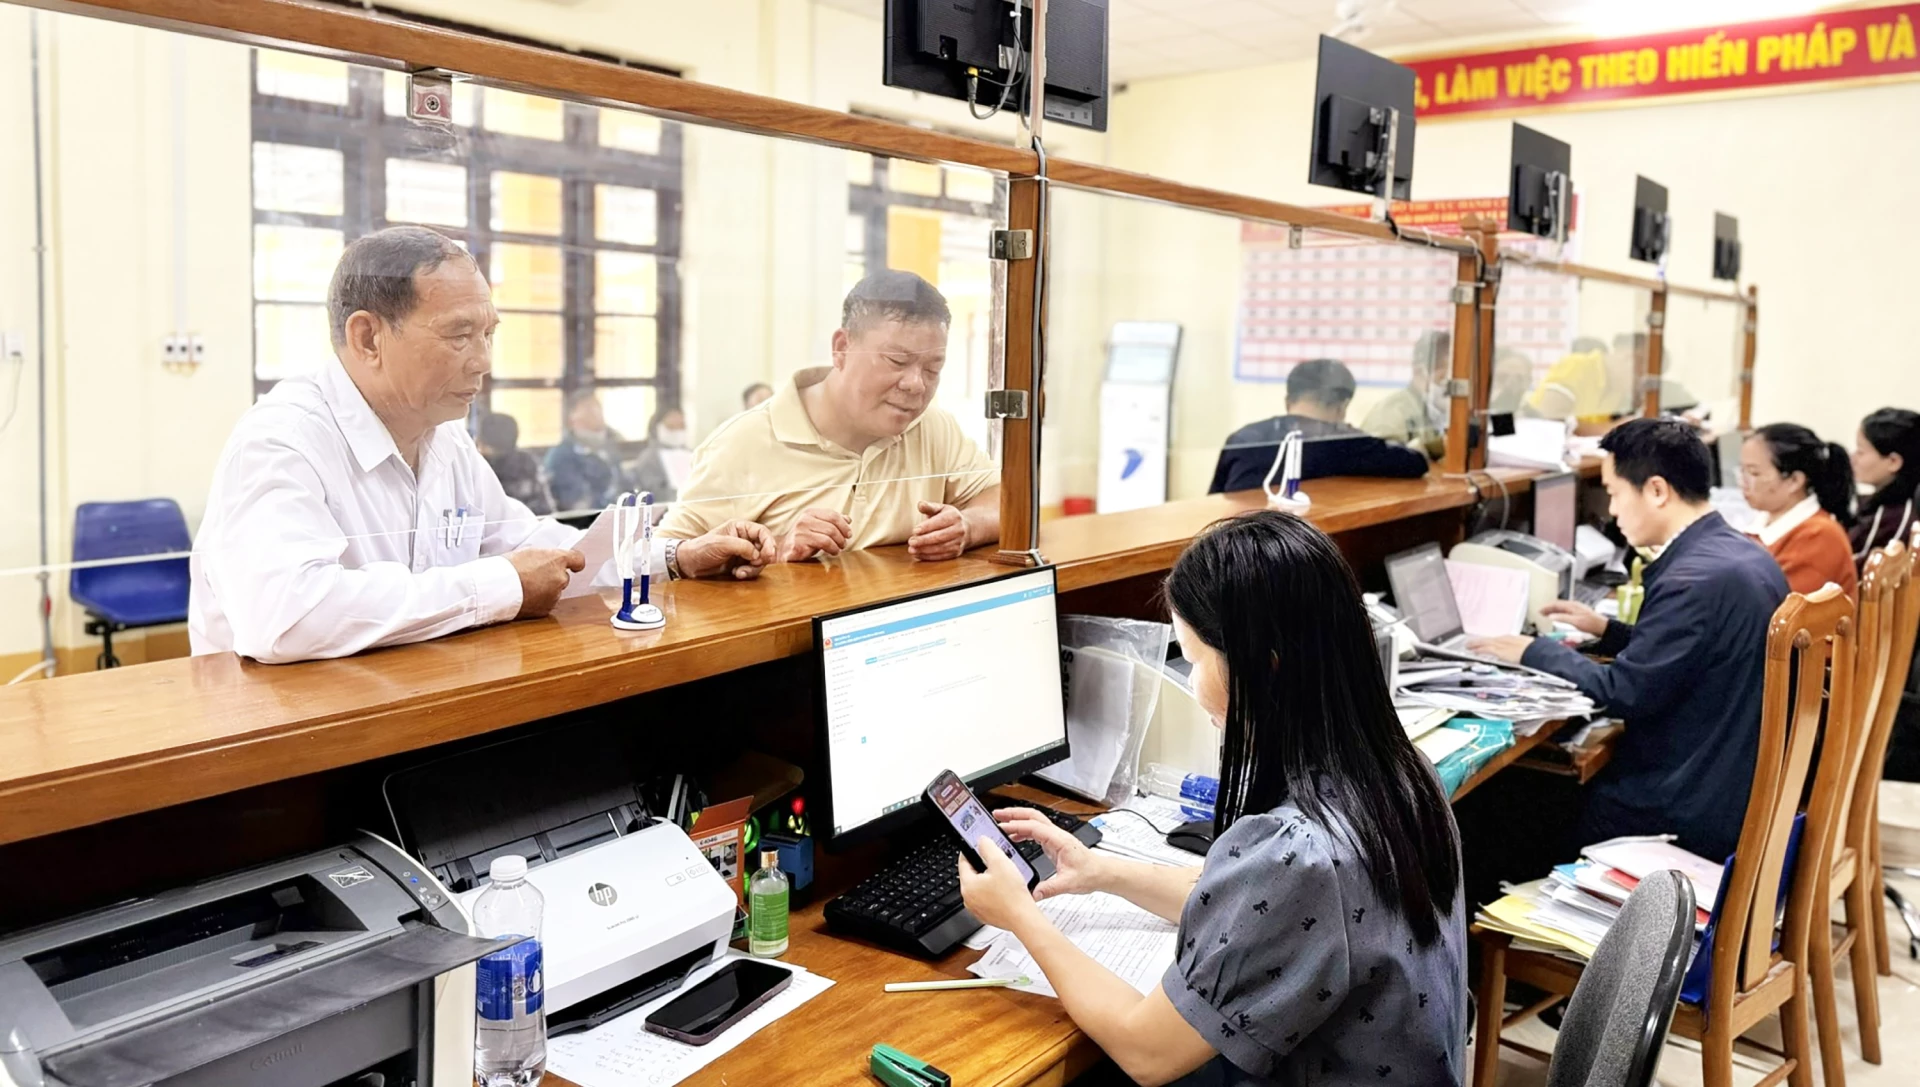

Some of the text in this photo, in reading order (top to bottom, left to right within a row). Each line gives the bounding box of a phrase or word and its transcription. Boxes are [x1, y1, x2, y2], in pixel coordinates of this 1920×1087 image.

[1435, 63, 1498, 105] LÀM
[1505, 54, 1572, 101] VIỆC
[1578, 47, 1659, 90] THEO
[1666, 30, 1748, 82] HIẾN
[1756, 22, 1857, 74] PHÁP
[1866, 13, 1916, 63] VÀ
[590, 882, 616, 907] hp
